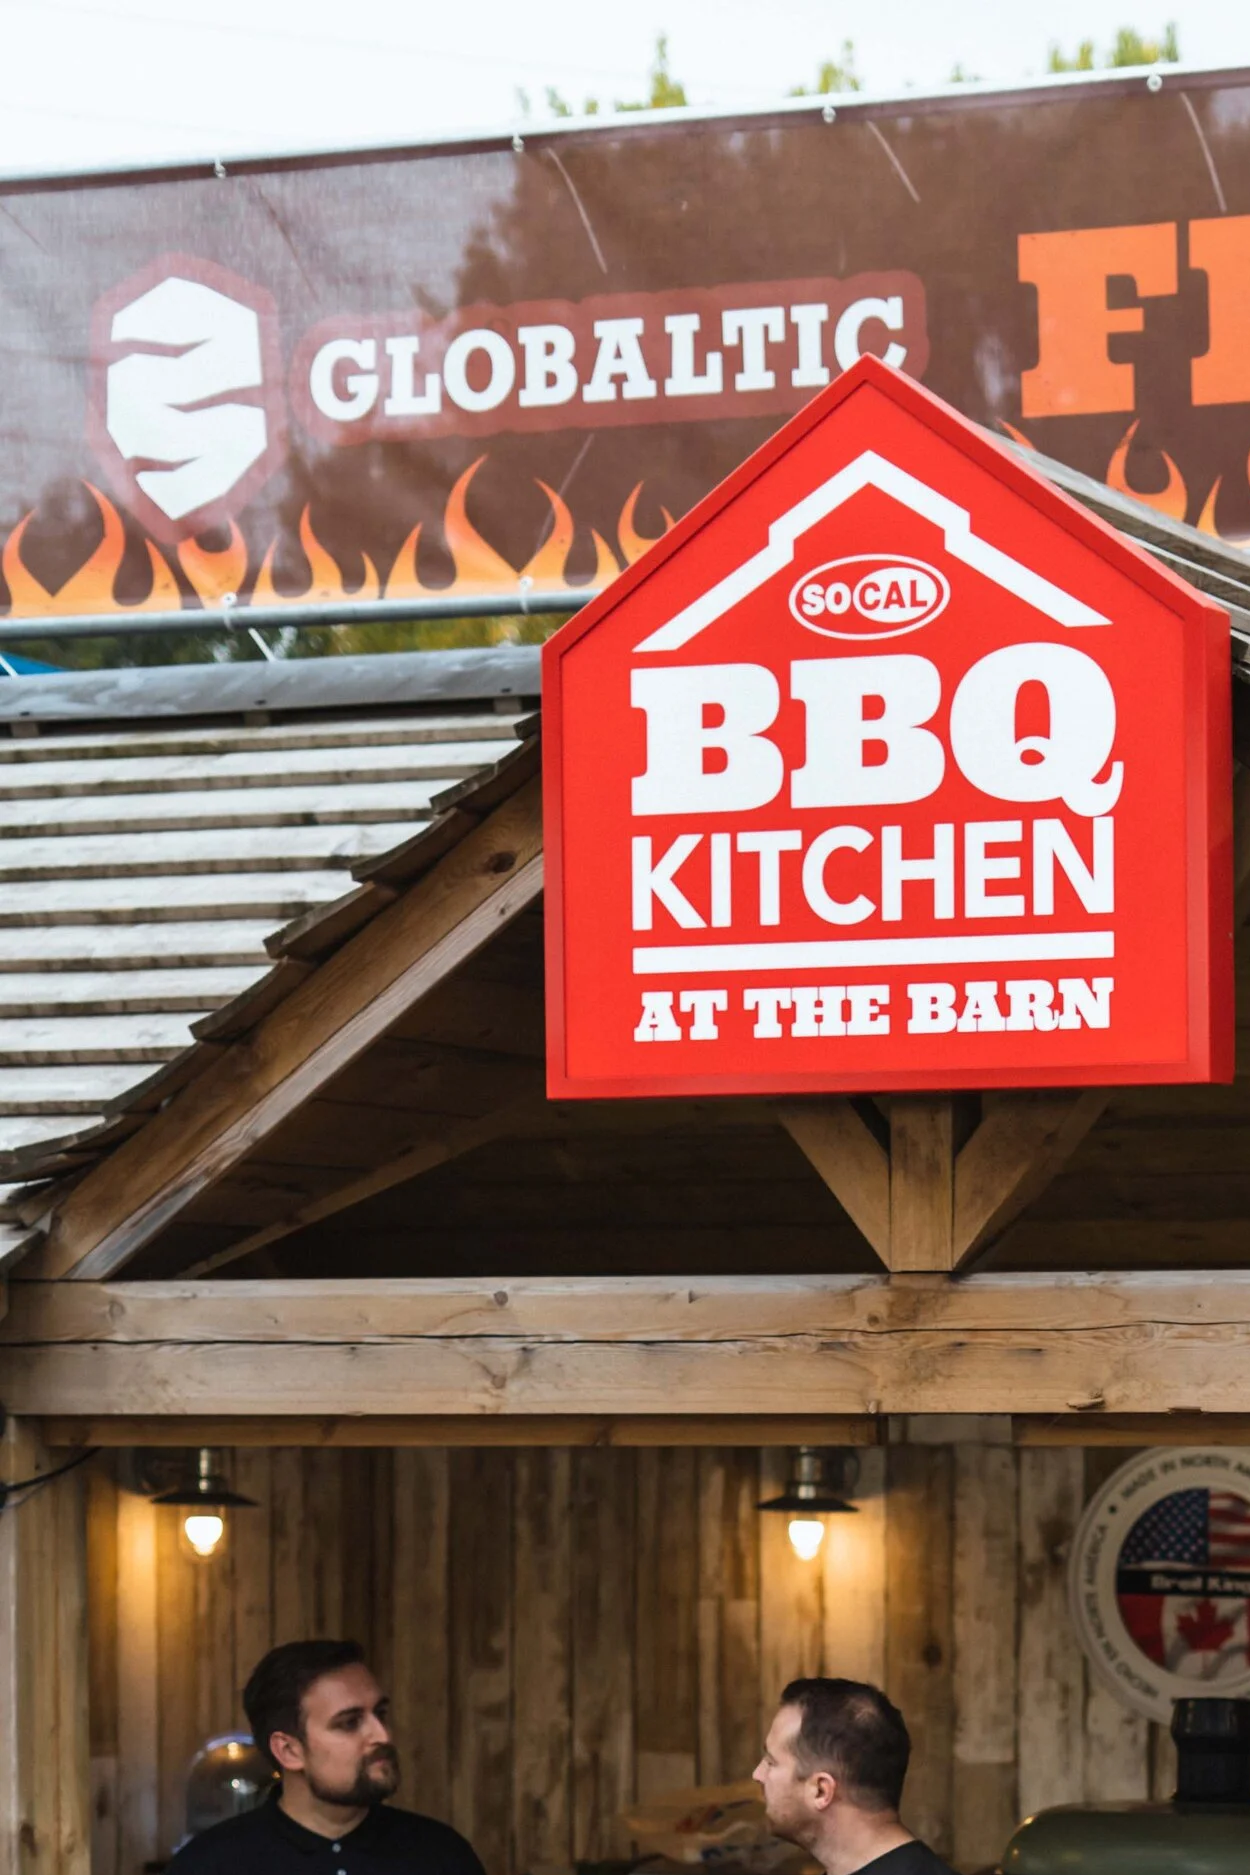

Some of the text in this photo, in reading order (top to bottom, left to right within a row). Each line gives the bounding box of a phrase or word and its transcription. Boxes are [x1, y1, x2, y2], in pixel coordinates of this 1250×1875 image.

[309, 296, 908, 423] GLOBALTIC
[801, 568, 930, 616] SOCAL
[630, 642, 1124, 816] BBQ
[632, 816, 1114, 931] KITCHEN
[634, 977, 1114, 1043] AT THE BARN
